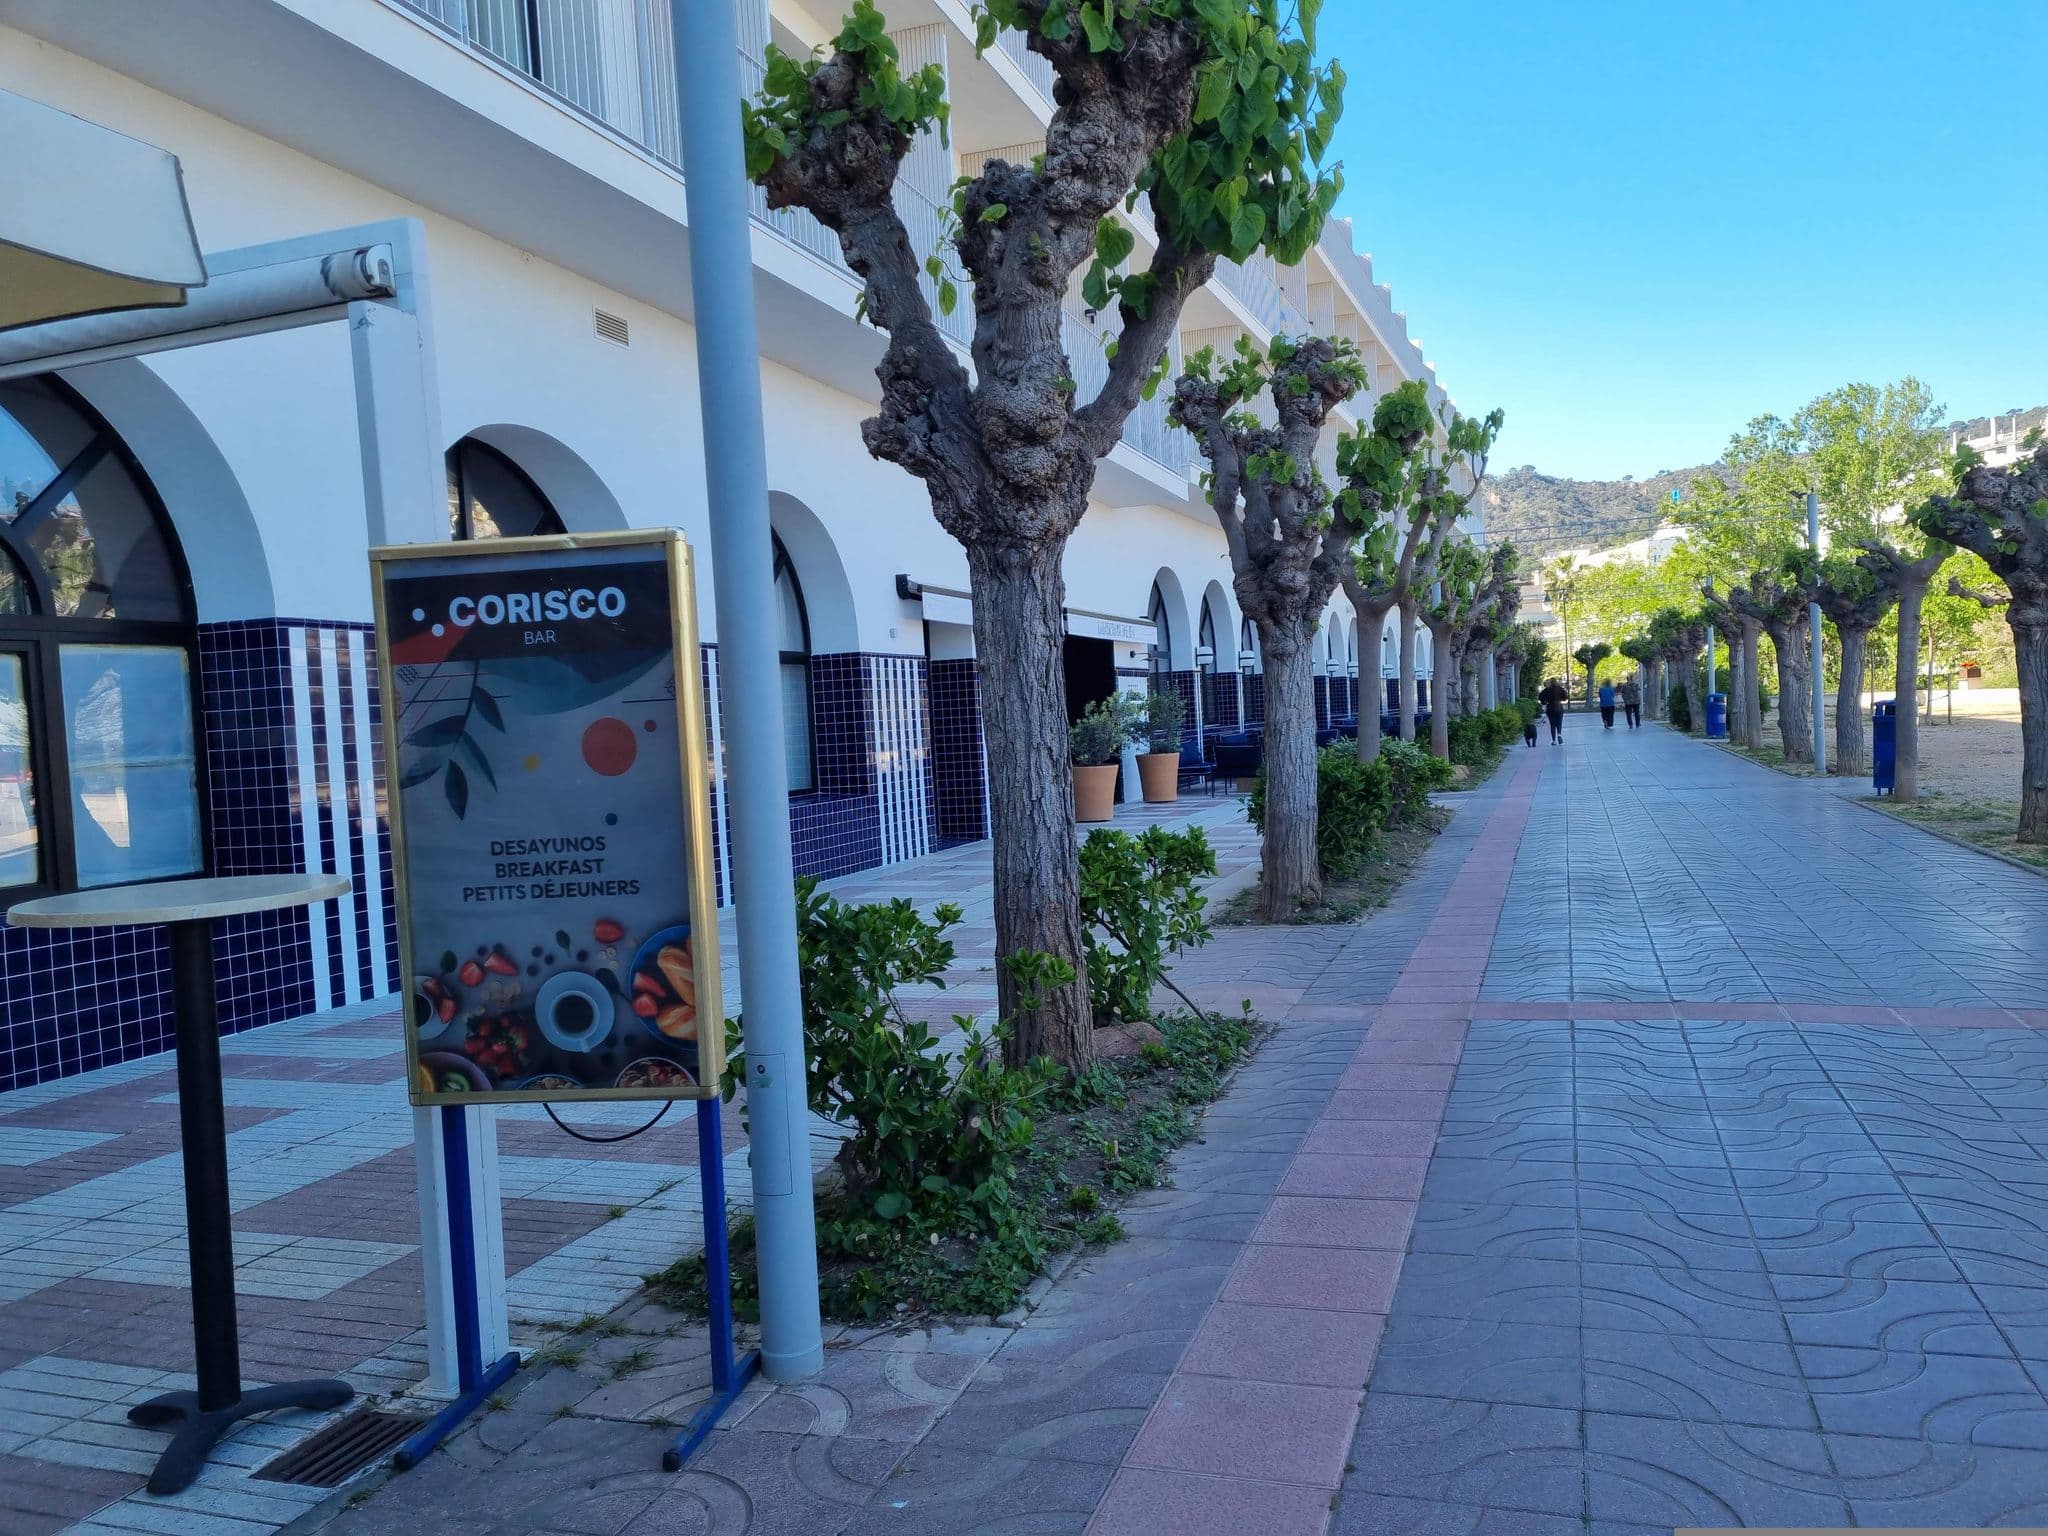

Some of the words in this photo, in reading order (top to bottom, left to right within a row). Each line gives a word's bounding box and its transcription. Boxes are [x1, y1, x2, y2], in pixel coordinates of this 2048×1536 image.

[449, 586, 627, 628] CORISCO
[523, 629, 557, 646] BAR
[490, 835, 606, 857] DESAYUNOS
[495, 858, 605, 879] BREAKFAST
[462, 883, 526, 902] PETITS
[530, 878, 641, 900] DÉJEUNERS
